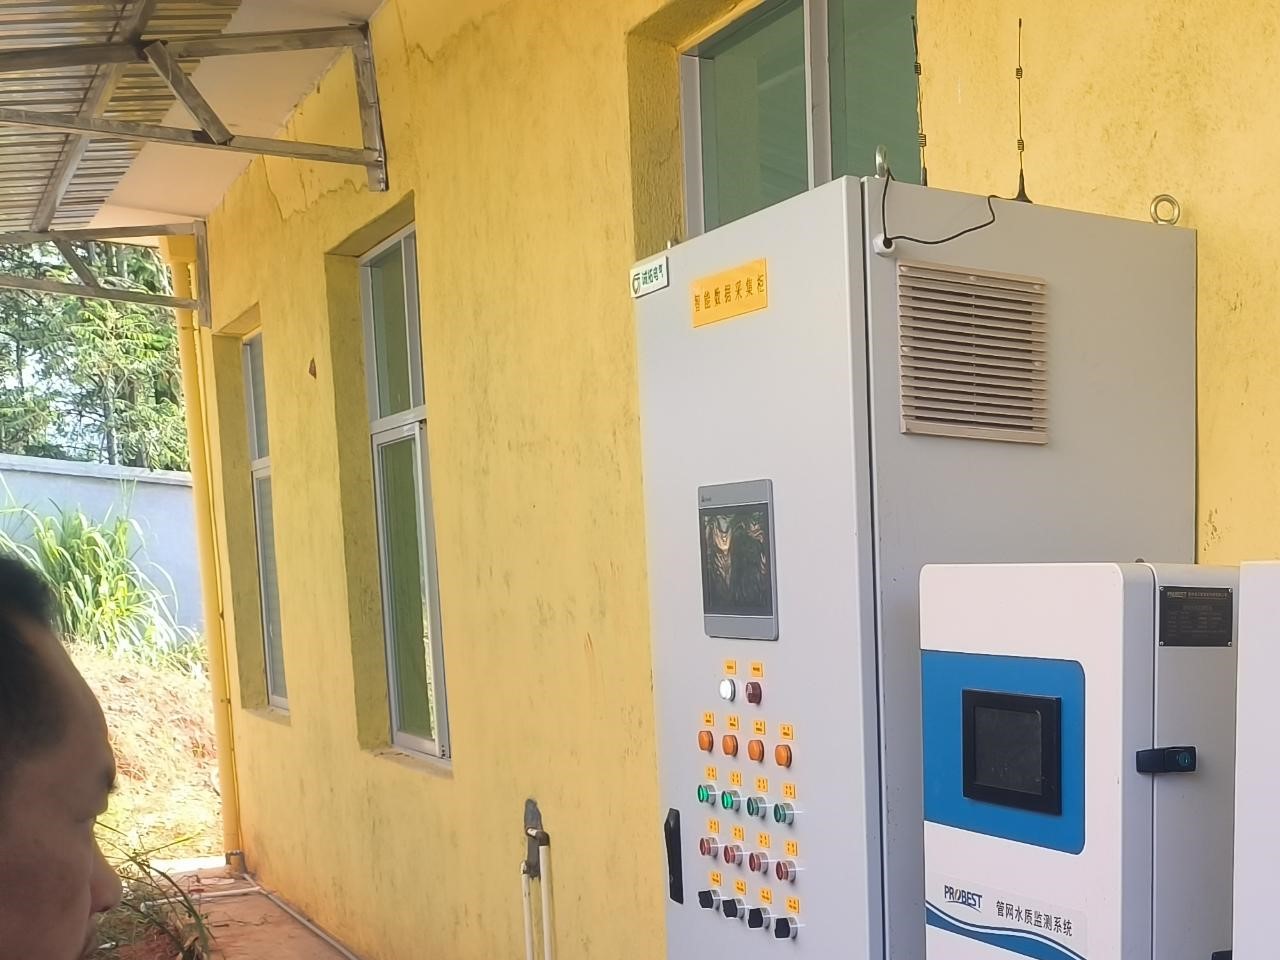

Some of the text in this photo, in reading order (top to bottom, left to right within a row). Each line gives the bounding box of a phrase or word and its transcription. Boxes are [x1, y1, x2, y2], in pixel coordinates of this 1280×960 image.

[944, 885, 983, 911] PROBEST
[996, 900, 1073, 937] 管网水质监测系统
